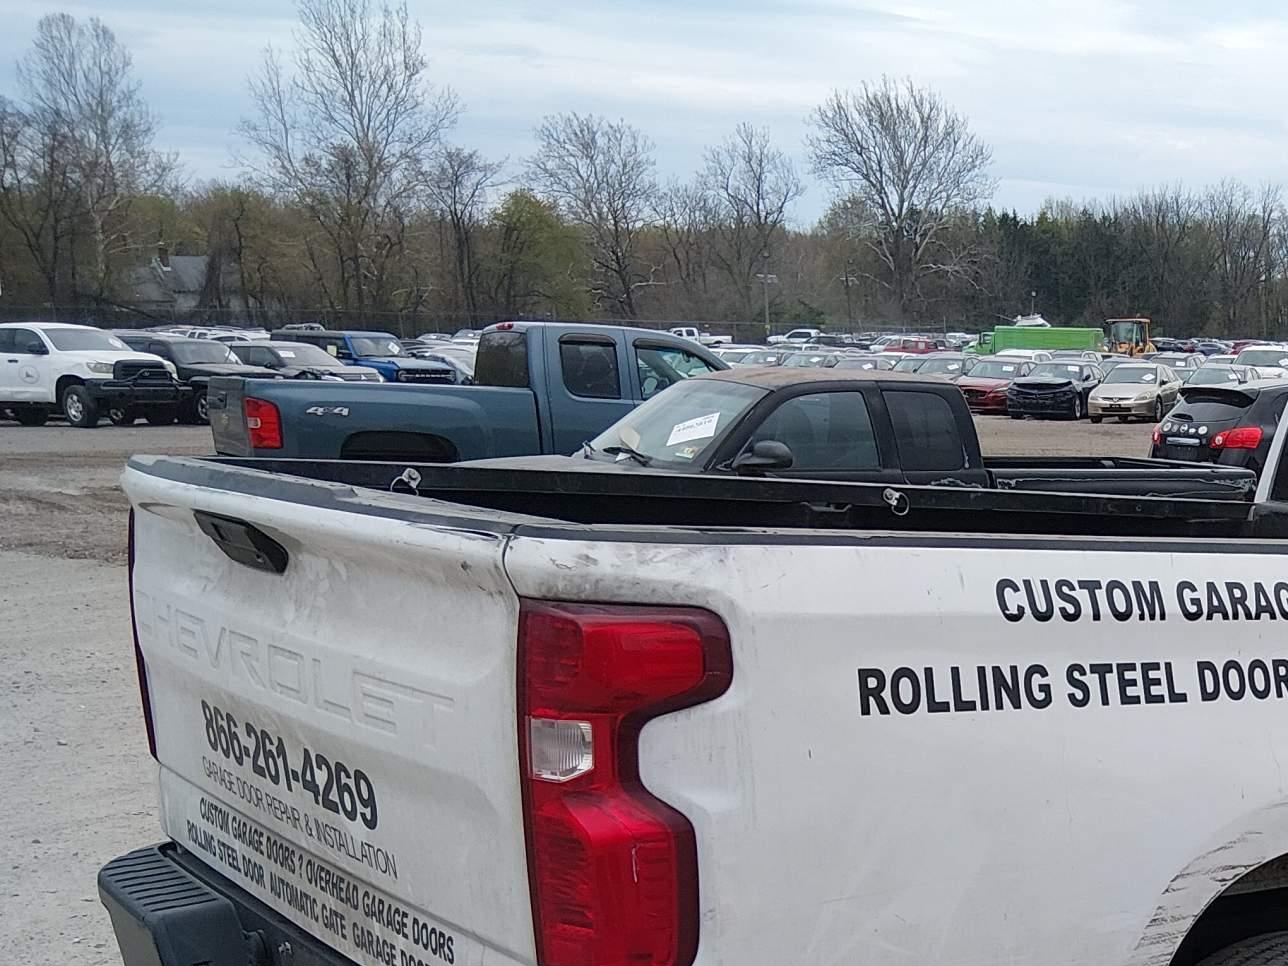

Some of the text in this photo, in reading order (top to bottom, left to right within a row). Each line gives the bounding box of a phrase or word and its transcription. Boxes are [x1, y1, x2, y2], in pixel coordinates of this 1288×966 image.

[996, 578, 1166, 622] CUSTOM
[857, 664, 1053, 716] ROLLING
[1066, 662, 1187, 708] STEEL
[201, 699, 378, 831] 866-261-4269
[202, 756, 398, 880] GARAGE DOOR REPAIR & INSTALLATION
[187, 820, 217, 857] ROLLING
[217, 838, 241, 873] STEEL
[242, 854, 266, 889] DOOR
[270, 871, 319, 922] AUTOMATIC
[322, 904, 347, 941] GATE
[200, 797, 230, 836] CUSTOM
[231, 816, 264, 856] GARAGE
[266, 835, 295, 874] DOORS
[306, 859, 359, 911] OVERHEAD
[362, 891, 409, 940] GARAGE
[412, 917, 455, 965] DOORS
